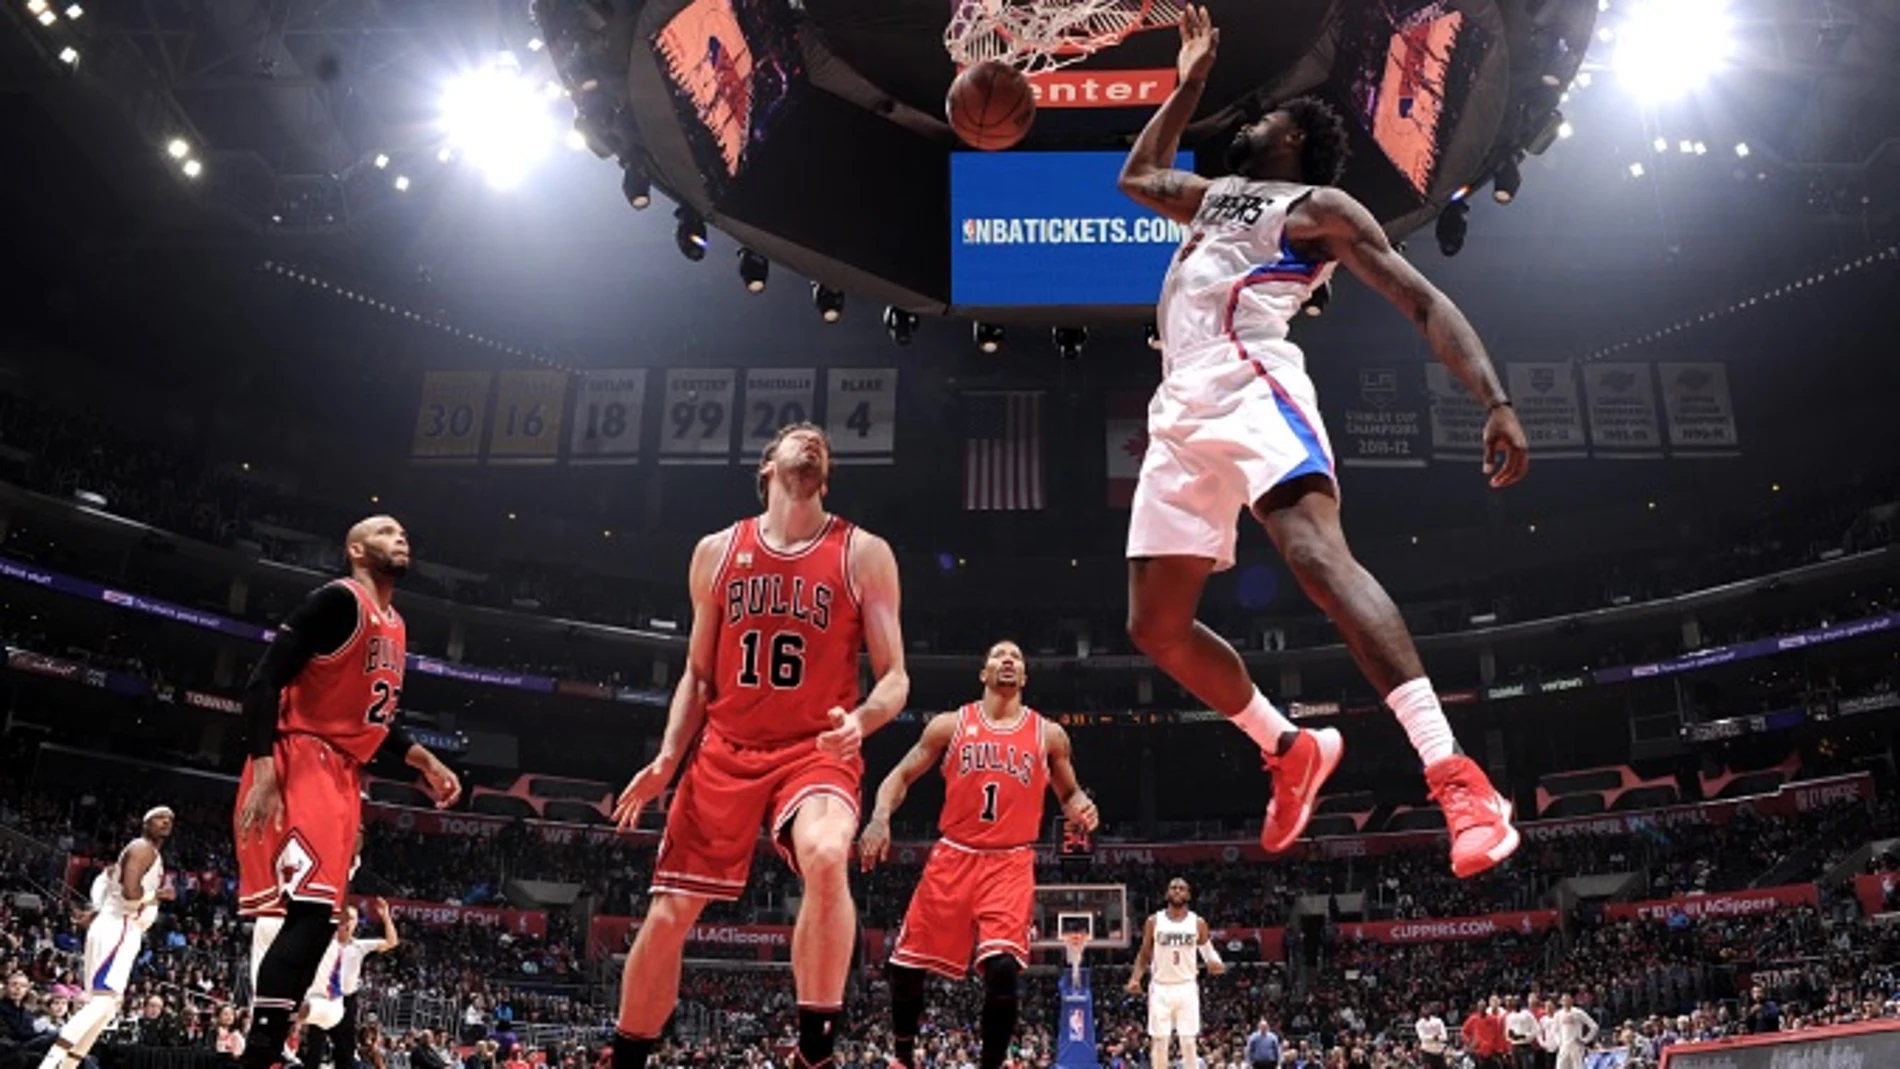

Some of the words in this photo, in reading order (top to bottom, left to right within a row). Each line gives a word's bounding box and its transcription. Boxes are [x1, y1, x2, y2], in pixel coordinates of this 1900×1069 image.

[974, 217, 1184, 244] NBATICKETS.COM
[840, 378, 885, 392] BLAKE
[424, 403, 474, 438] 30
[506, 403, 545, 438] 16
[585, 401, 628, 440] 18
[670, 398, 725, 440] 99
[845, 400, 872, 437] 4
[1345, 422, 1419, 436] CHAMPIONS
[1358, 439, 1411, 455] 2011-12
[726, 574, 833, 633] BULLS
[737, 630, 806, 690] 16
[185, 690, 244, 715] TOSHIBA
[959, 741, 1035, 788] BULLS
[979, 780, 1000, 824] 1
[1390, 920, 1496, 940] CLIPPERS.COM
